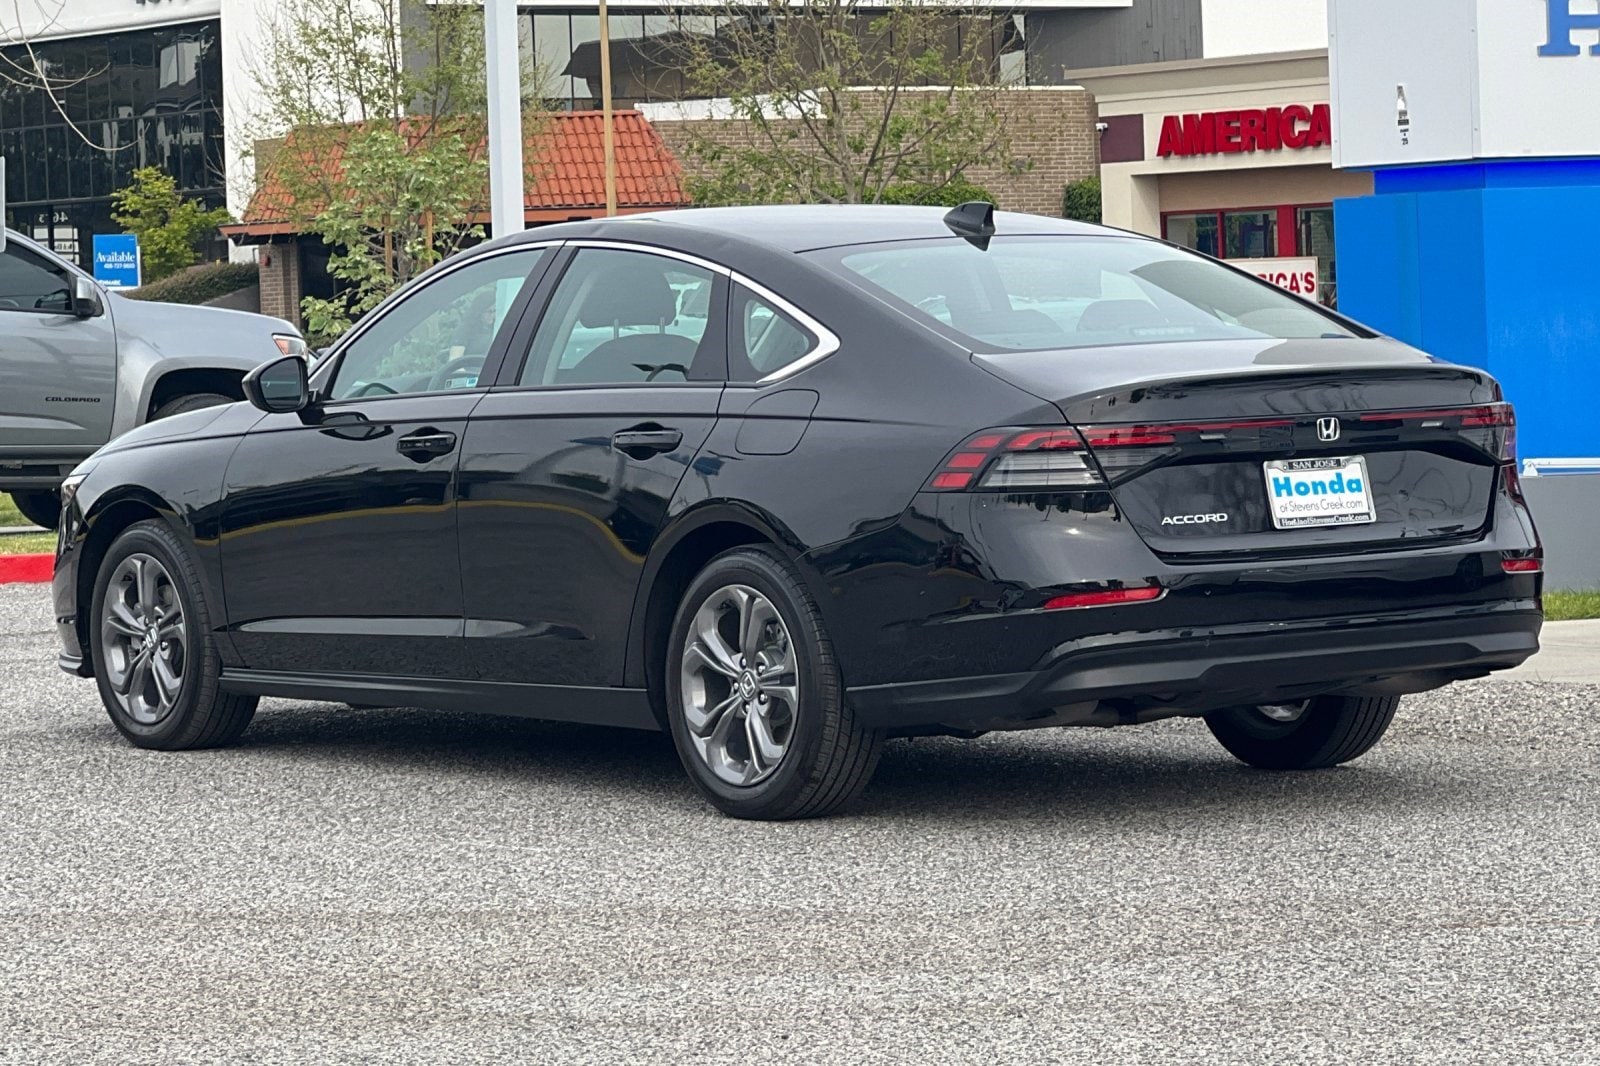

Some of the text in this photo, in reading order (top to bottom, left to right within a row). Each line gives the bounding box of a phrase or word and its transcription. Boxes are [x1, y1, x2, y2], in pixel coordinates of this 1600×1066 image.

[96, 251, 136, 262] Available
[1292, 459, 1337, 470] SAN JOSE
[1272, 472, 1362, 497] Honda
[1279, 497, 1363, 513] of Stevens Creek.com
[1161, 513, 1228, 525] ACCORD
